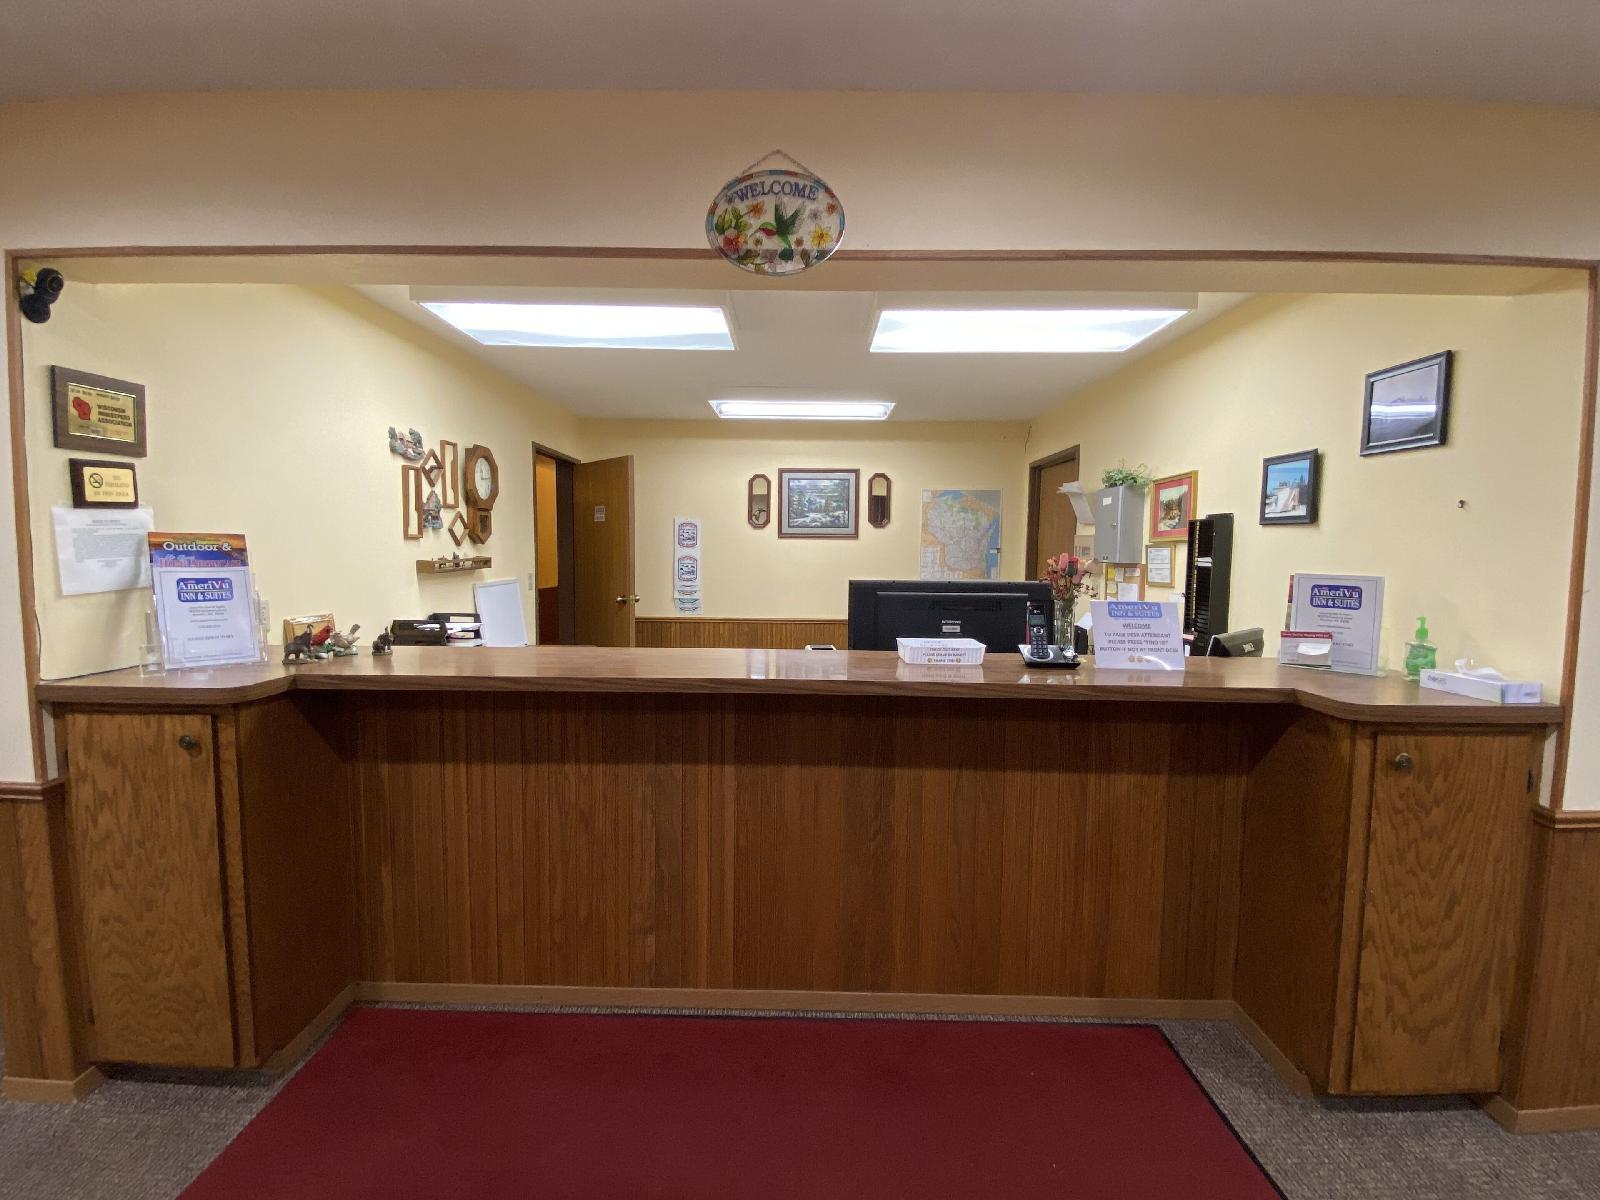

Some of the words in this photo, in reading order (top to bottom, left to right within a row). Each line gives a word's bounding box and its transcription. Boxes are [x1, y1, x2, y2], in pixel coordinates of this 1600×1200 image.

[732, 180, 820, 202] WELCOME
[97, 405, 126, 413] WISCONSIN
[97, 417, 133, 428] ASSOCIATION
[163, 541, 219, 551] Outdoor
[222, 542, 232, 551] &
[178, 581, 230, 591] AmeriVu
[180, 591, 196, 601] INN
[197, 592, 204, 600] &
[204, 591, 233, 600] SUITES
[1311, 587, 1360, 599] AmeriVu
[1109, 602, 1159, 611] AmeriVu
[1312, 597, 1327, 607] INN
[1327, 598, 1334, 607] &
[1334, 599, 1360, 609] SUITES
